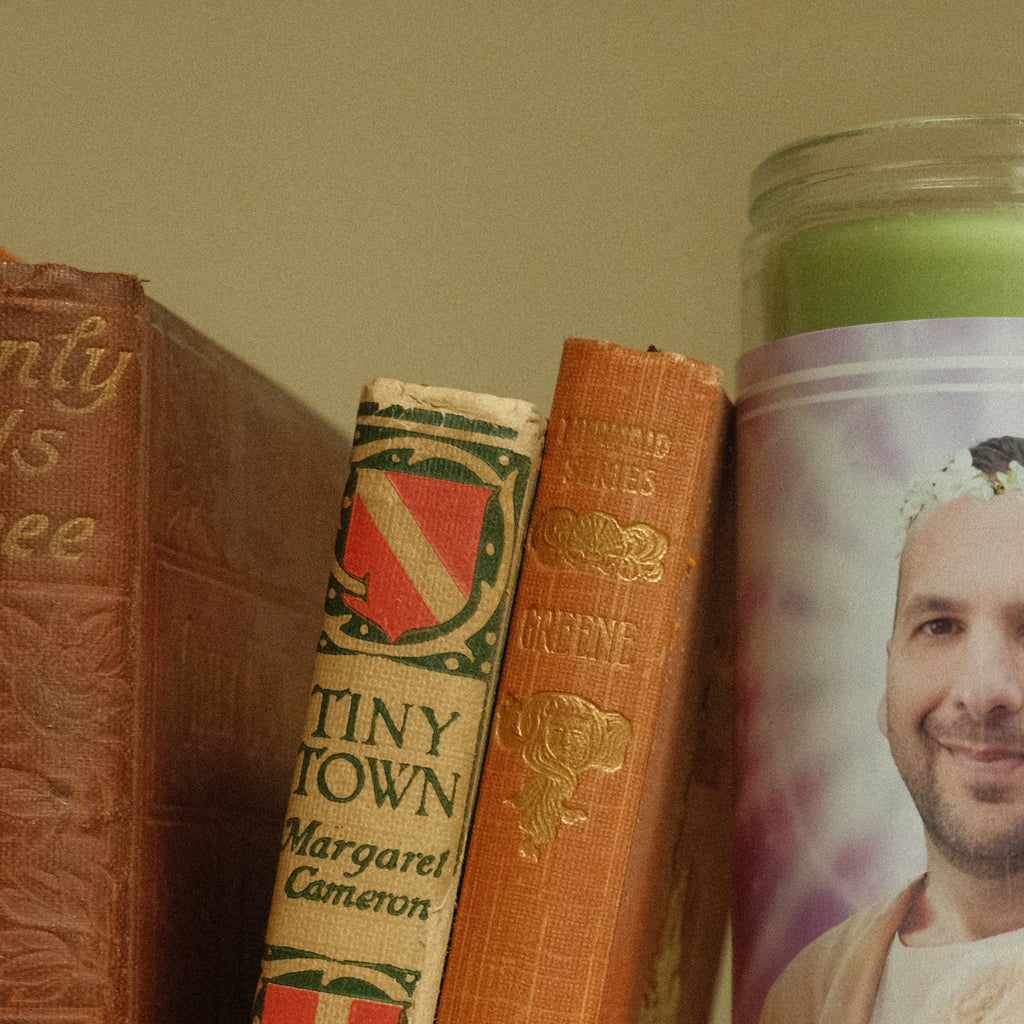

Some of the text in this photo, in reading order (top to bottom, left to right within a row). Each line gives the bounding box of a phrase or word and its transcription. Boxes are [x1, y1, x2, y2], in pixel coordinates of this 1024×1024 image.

[311, 684, 460, 757] TINY
[293, 742, 460, 818] TOWN
[284, 865, 431, 921] Cameron
